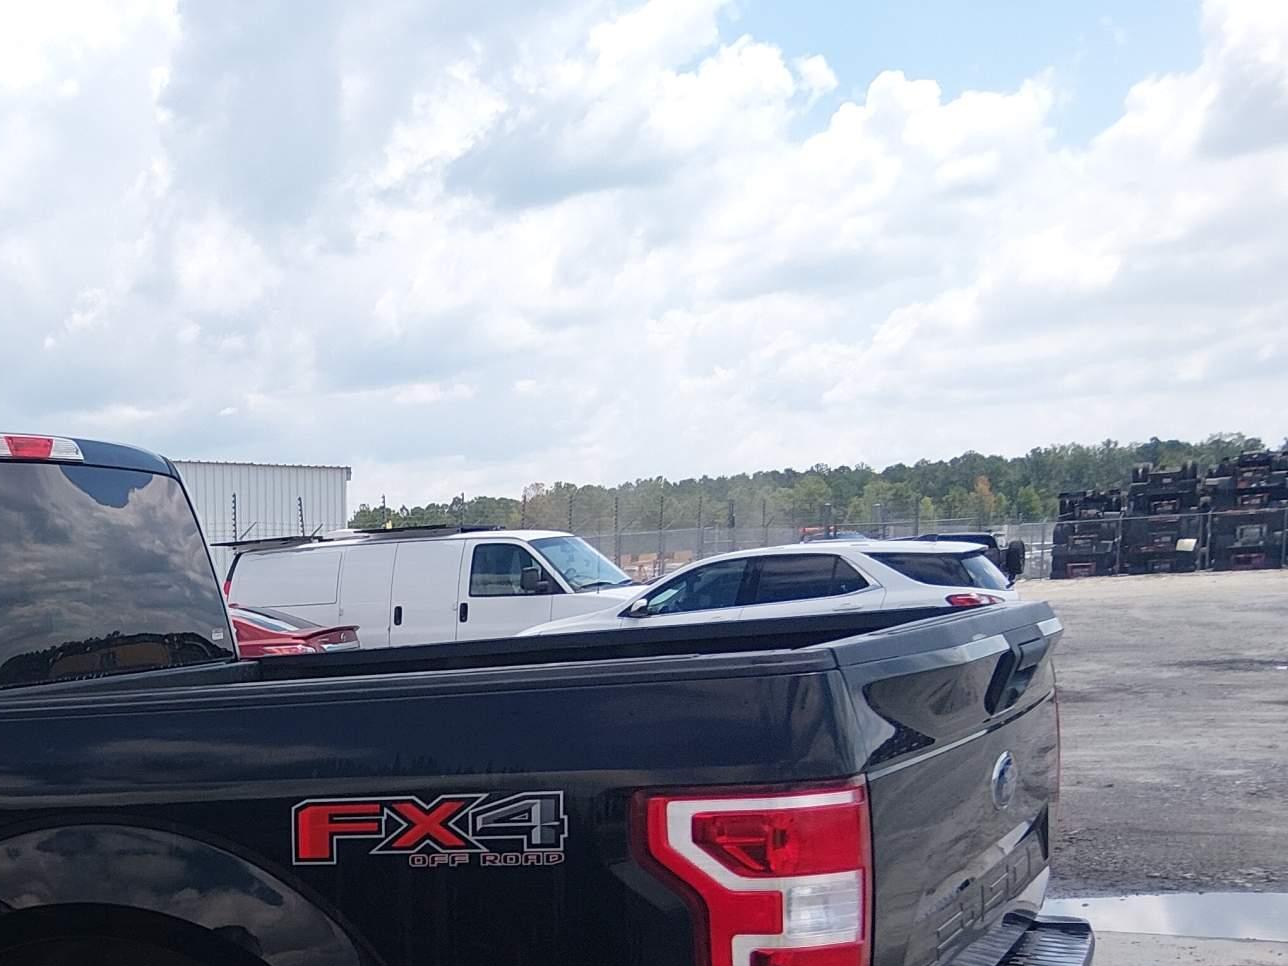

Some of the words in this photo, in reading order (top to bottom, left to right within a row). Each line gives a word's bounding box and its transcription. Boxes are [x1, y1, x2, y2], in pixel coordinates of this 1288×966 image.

[291, 790, 569, 866] FX4
[408, 852, 471, 868] OFF
[479, 851, 565, 867] ROAD
